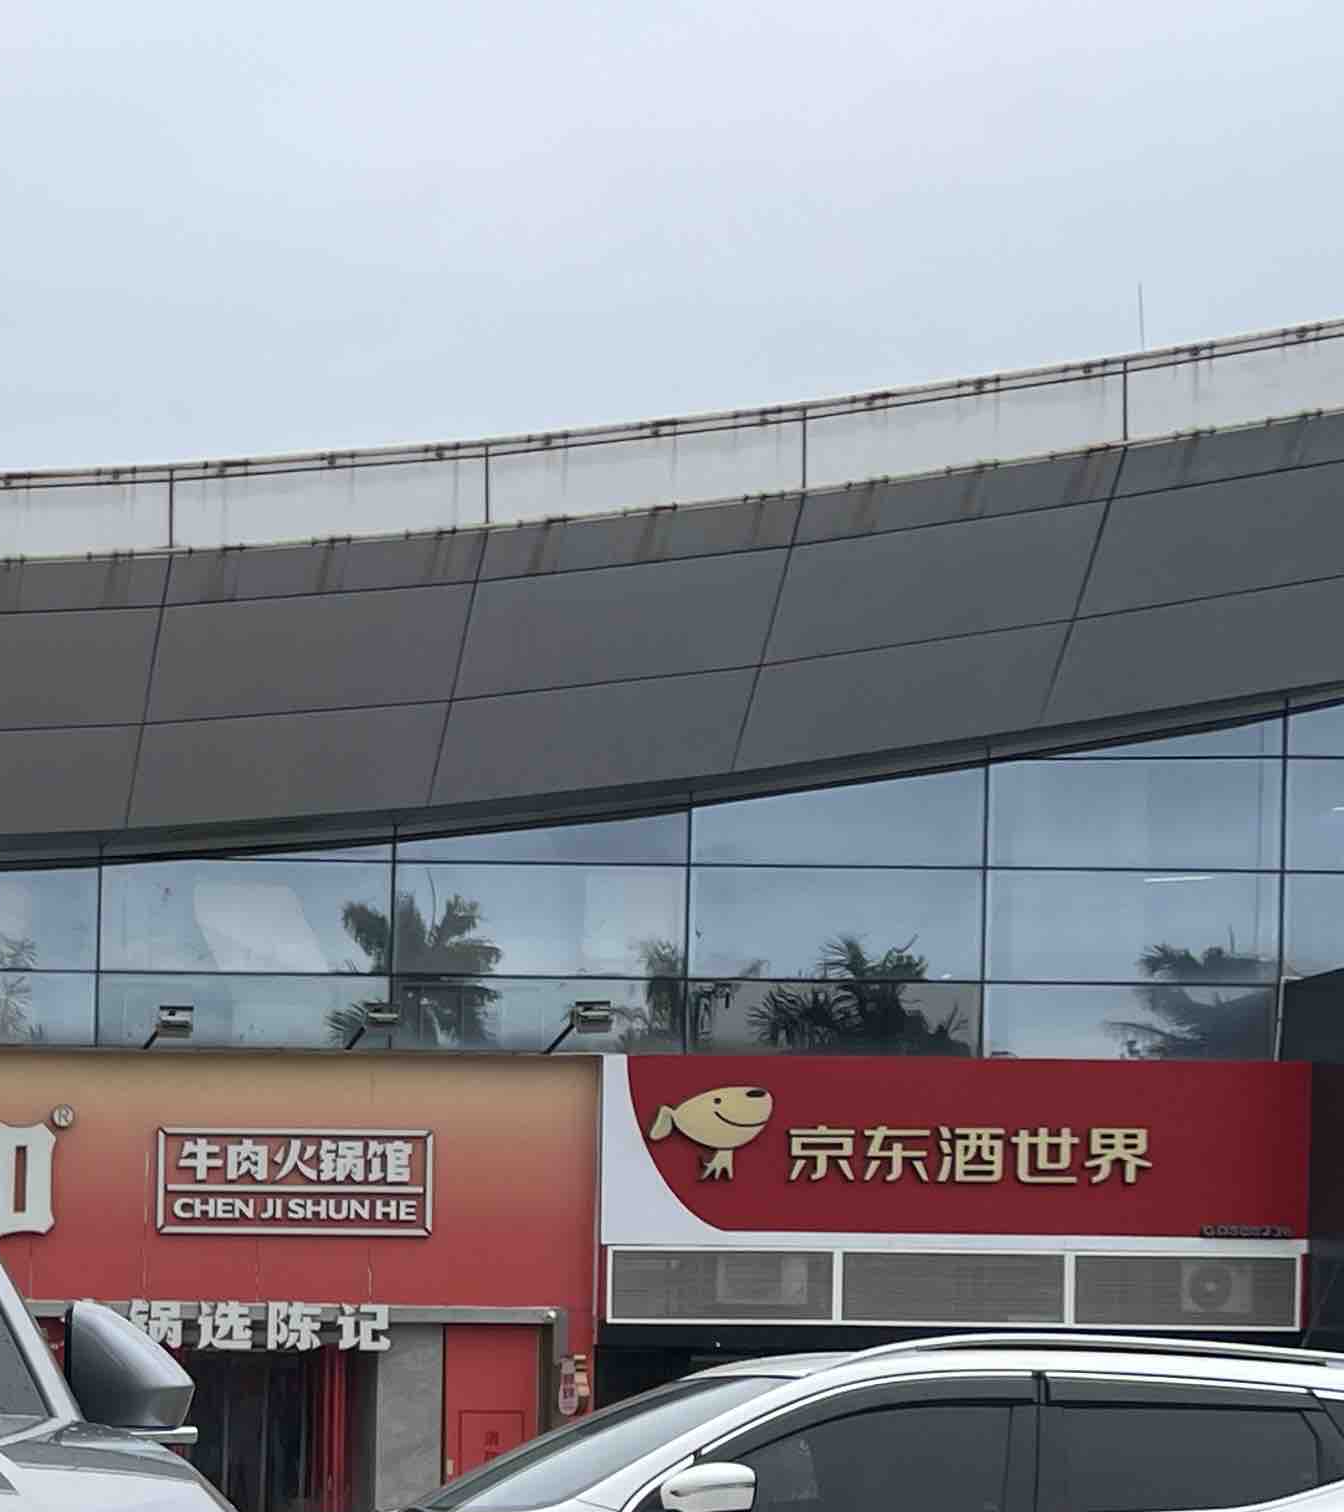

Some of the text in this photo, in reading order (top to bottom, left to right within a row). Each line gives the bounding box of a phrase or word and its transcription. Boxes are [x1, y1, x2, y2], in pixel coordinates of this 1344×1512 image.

[178, 1138, 413, 1184] 牛肉火锅馆
[788, 1126, 1153, 1185] 京东酒世界
[173, 1197, 417, 1222] CHEN JI SHUN HE
